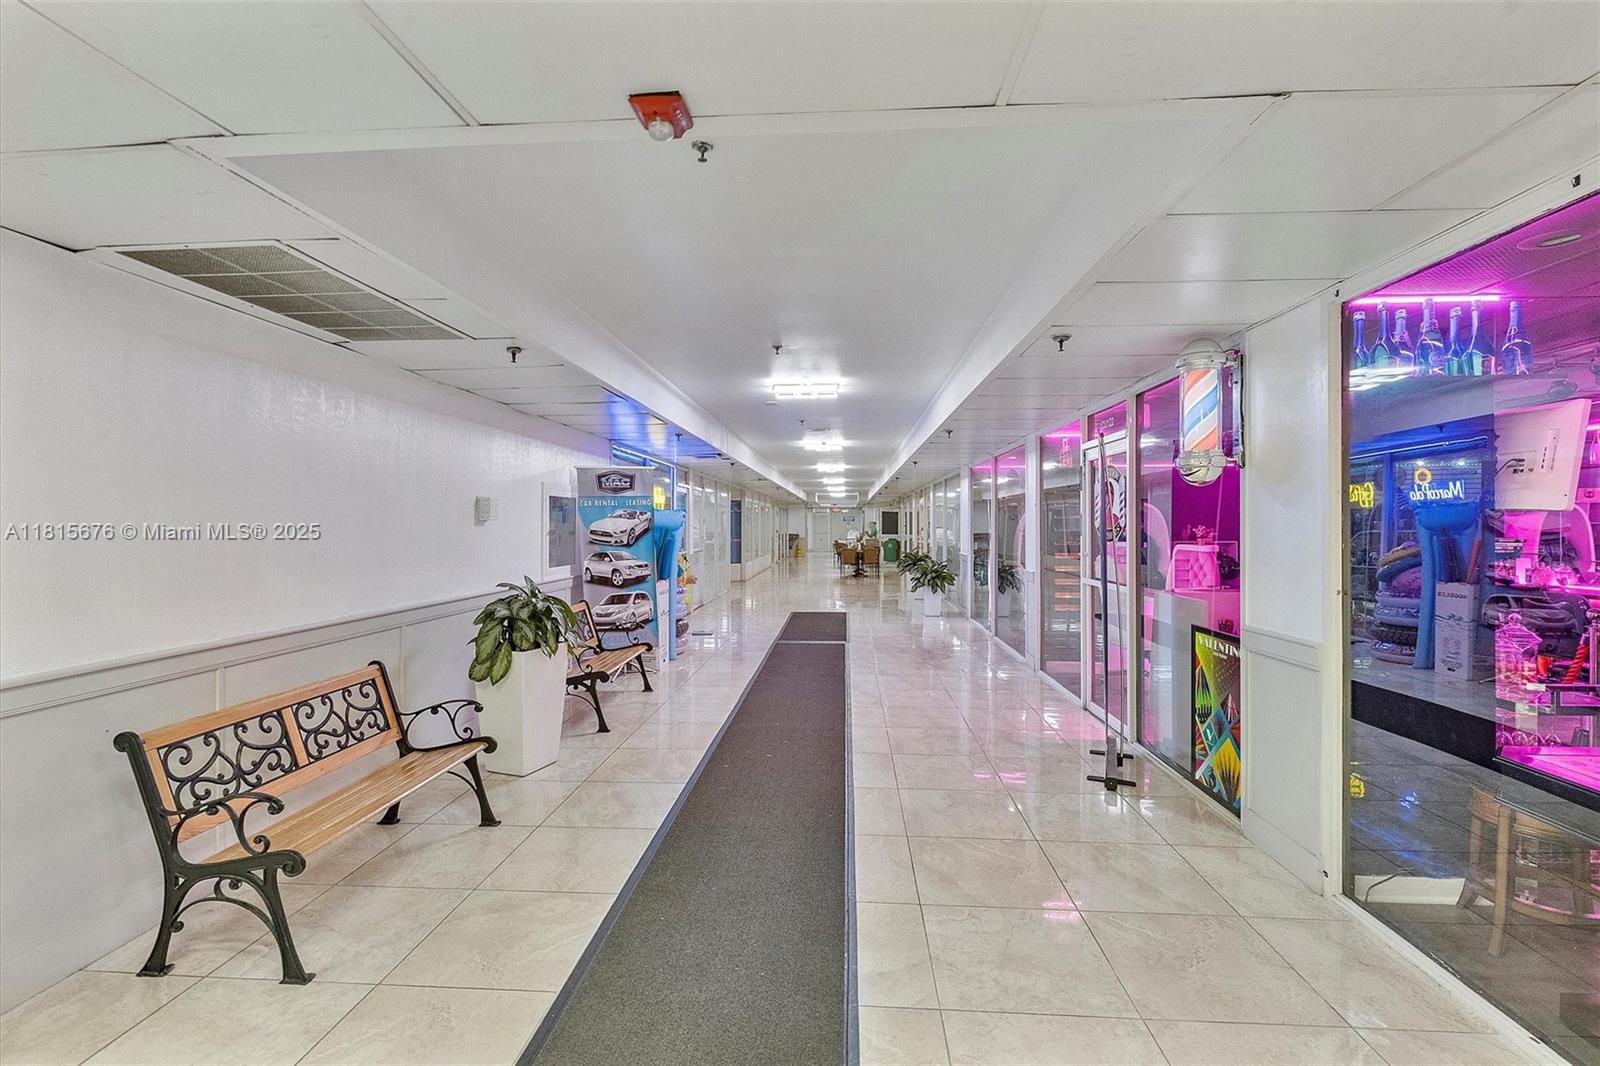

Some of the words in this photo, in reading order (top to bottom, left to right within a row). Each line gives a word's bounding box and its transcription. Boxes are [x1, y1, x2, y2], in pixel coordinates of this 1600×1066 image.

[579, 499, 593, 507] CAR
[594, 499, 619, 507] RENTAL
[625, 498, 652, 506] LEASING
